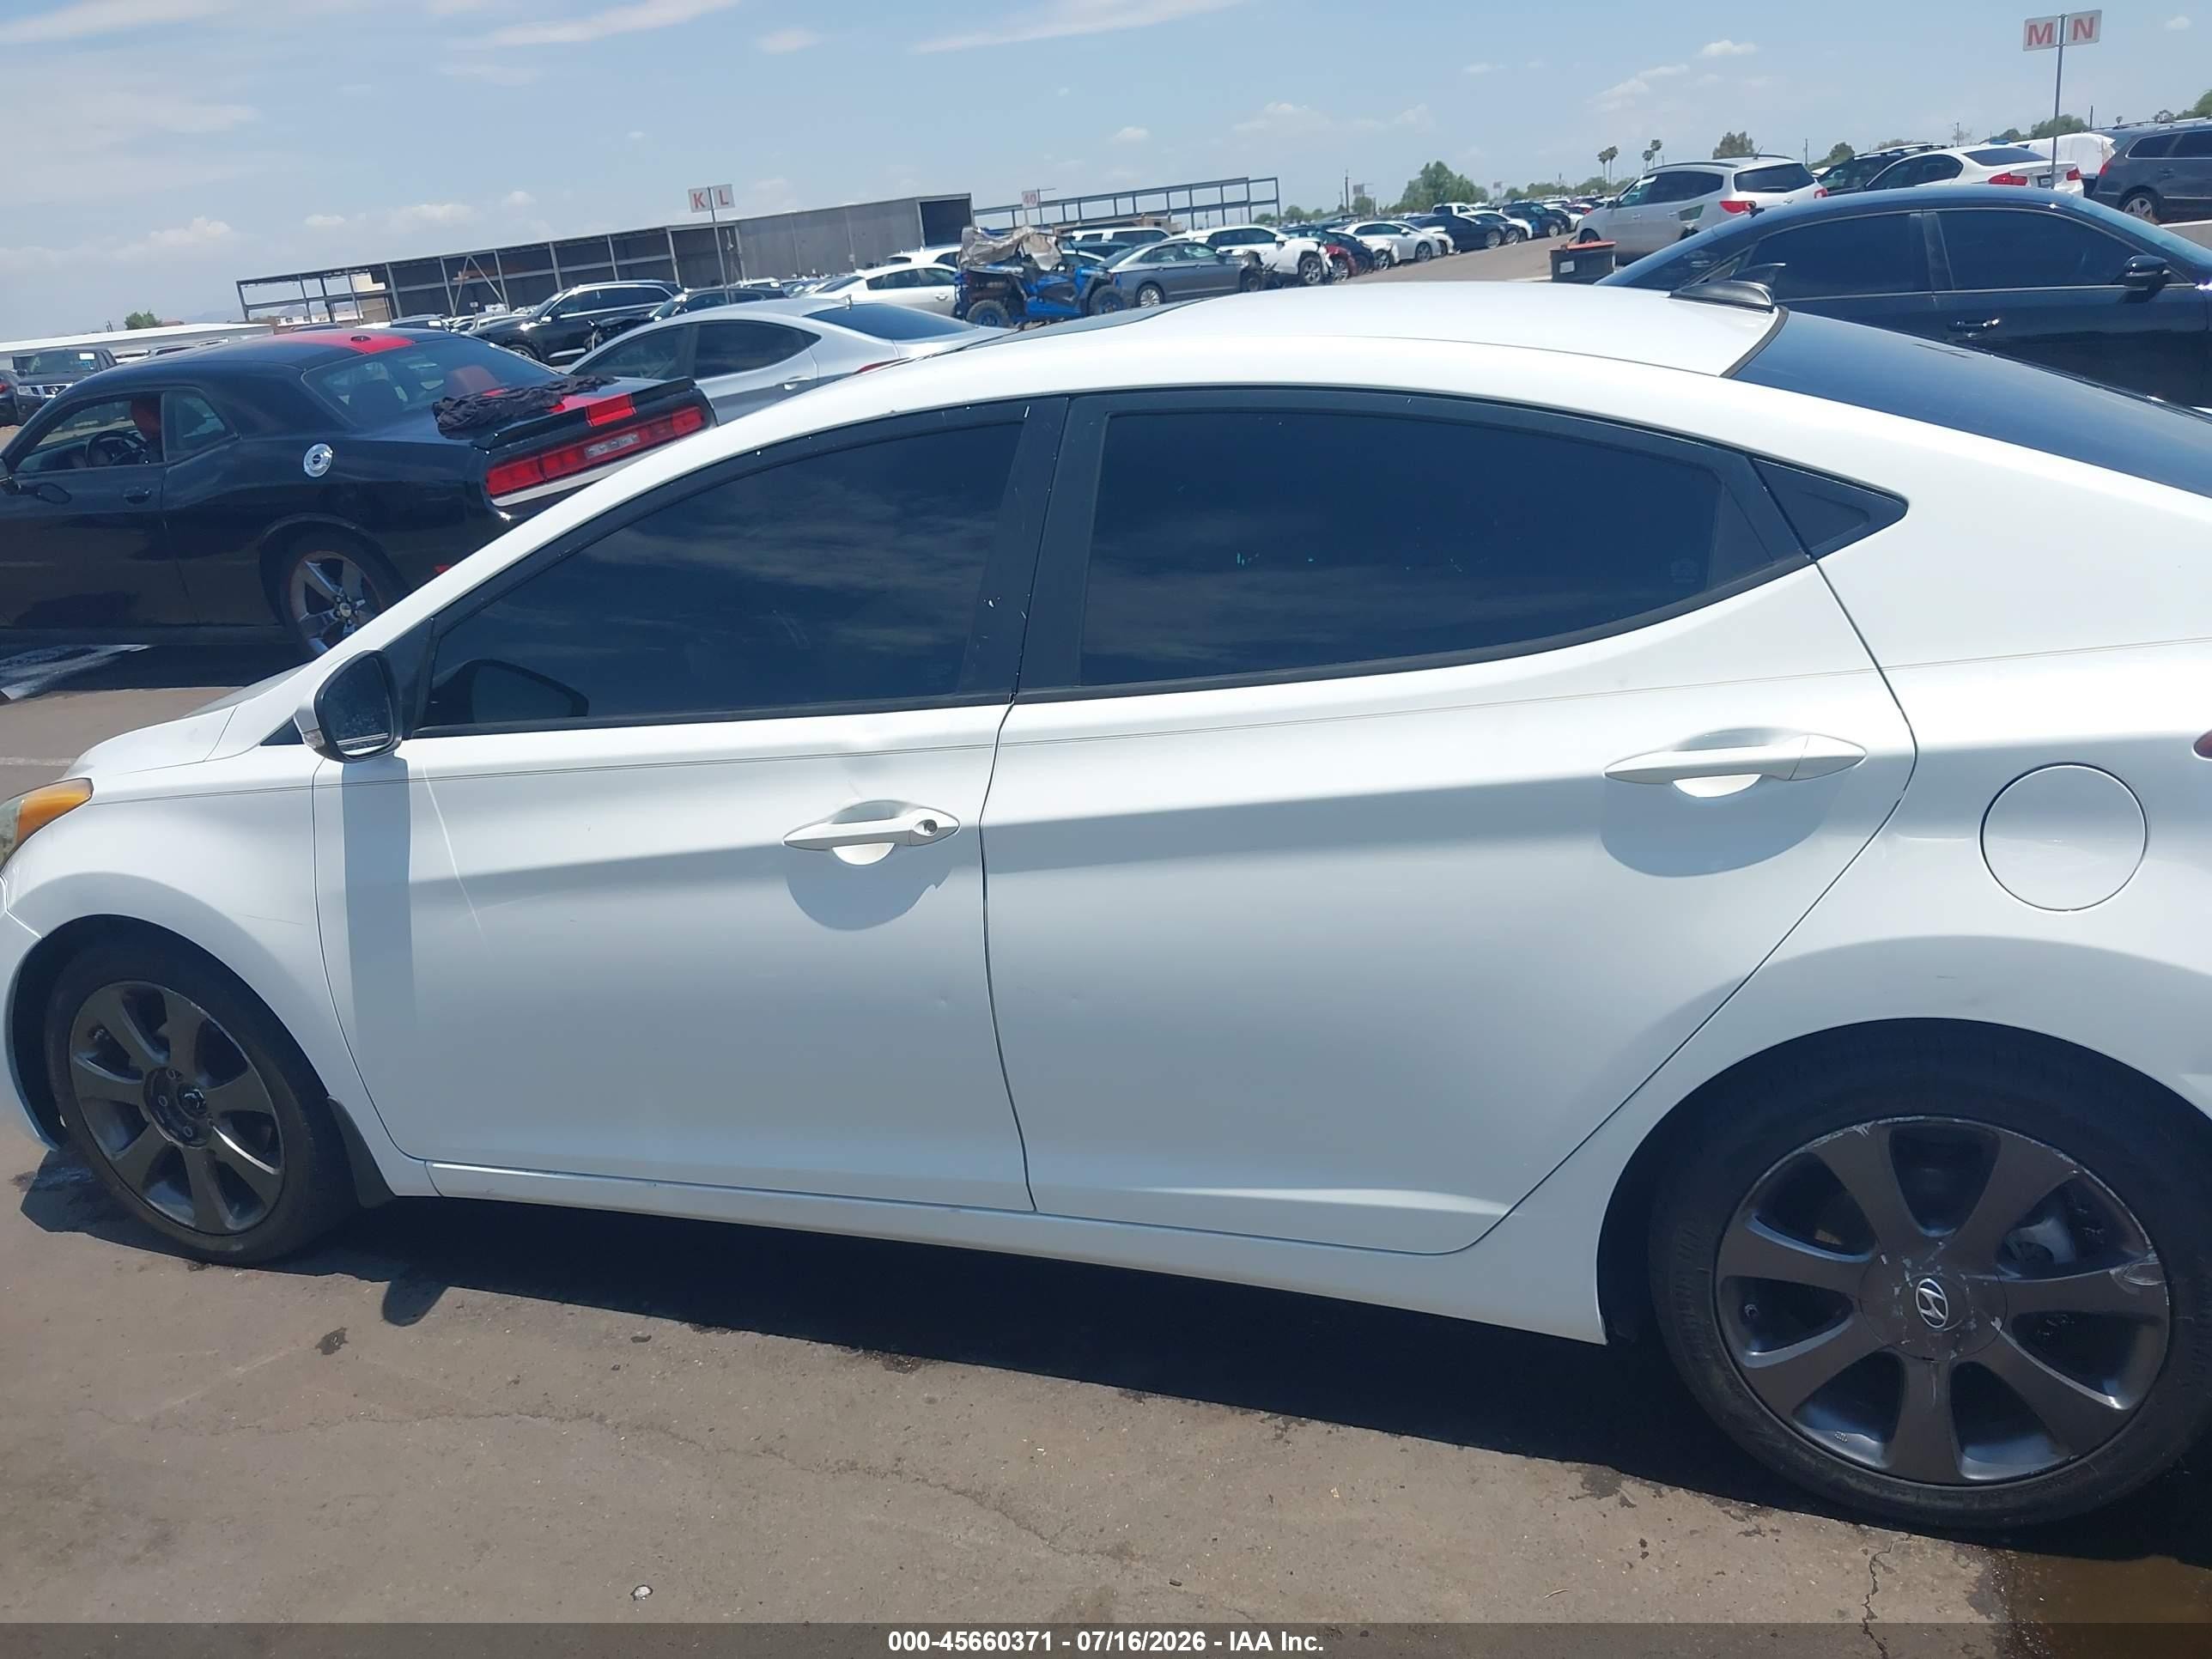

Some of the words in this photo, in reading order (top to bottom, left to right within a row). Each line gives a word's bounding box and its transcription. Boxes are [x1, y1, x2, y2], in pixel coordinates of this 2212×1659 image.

[2027, 21, 2053, 46] M
[2073, 16, 2095, 41] N
[693, 191, 706, 210] K
[719, 189, 729, 206] L
